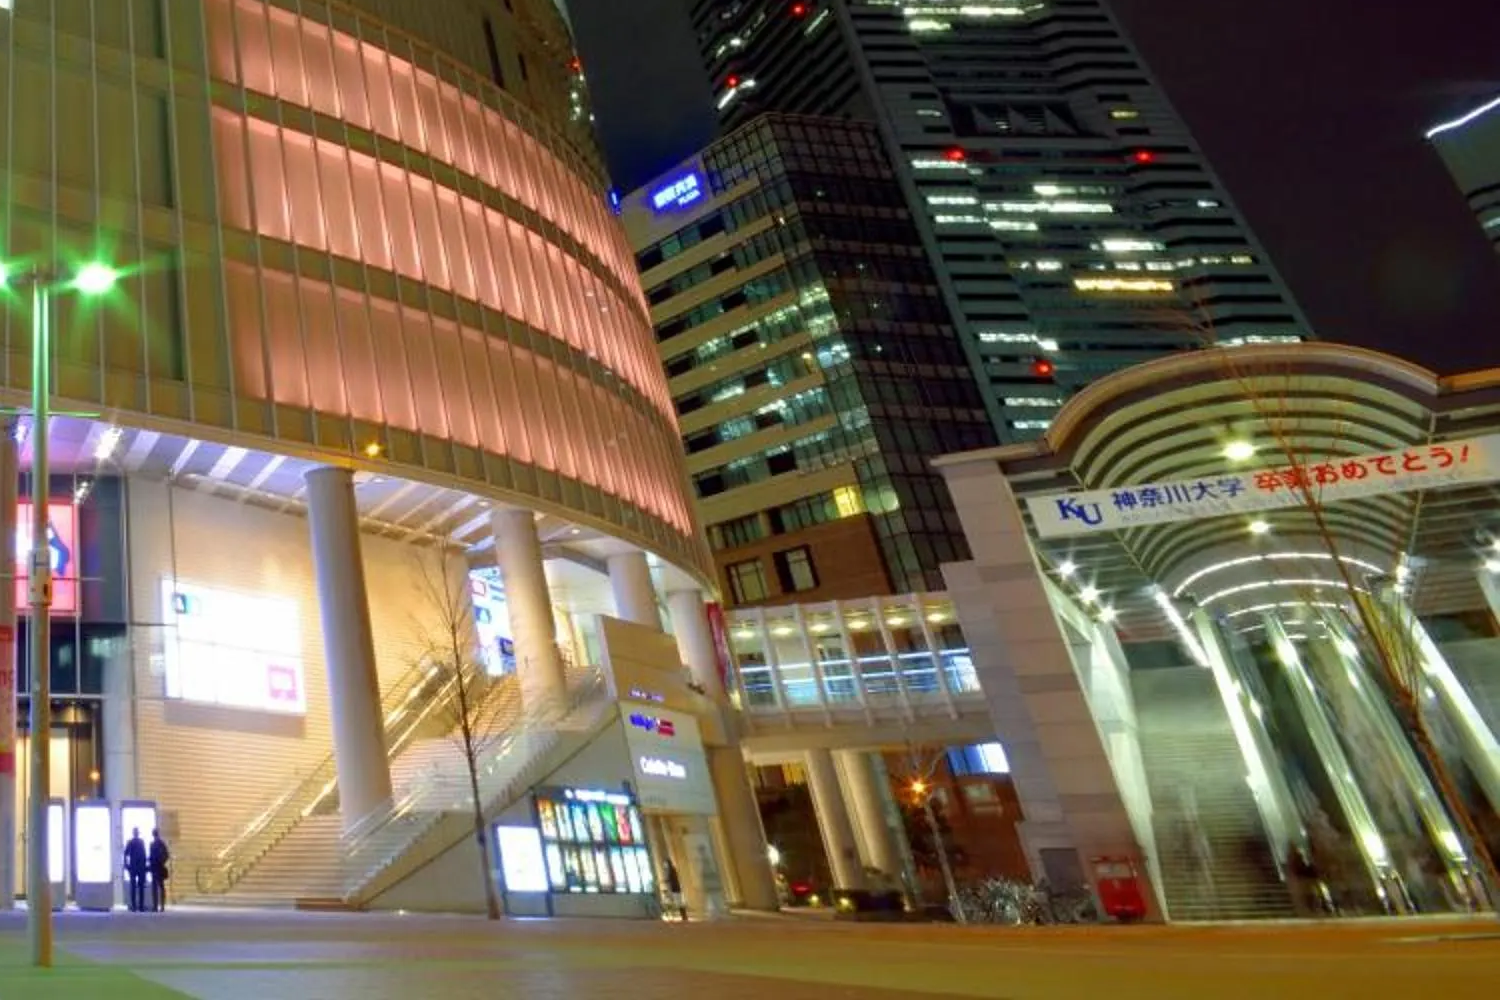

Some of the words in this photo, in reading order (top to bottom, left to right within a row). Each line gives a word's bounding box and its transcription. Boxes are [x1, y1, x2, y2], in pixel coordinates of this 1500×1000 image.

[1055, 497, 1103, 526] KU
[1110, 477, 1245, 511] 神奈川大学
